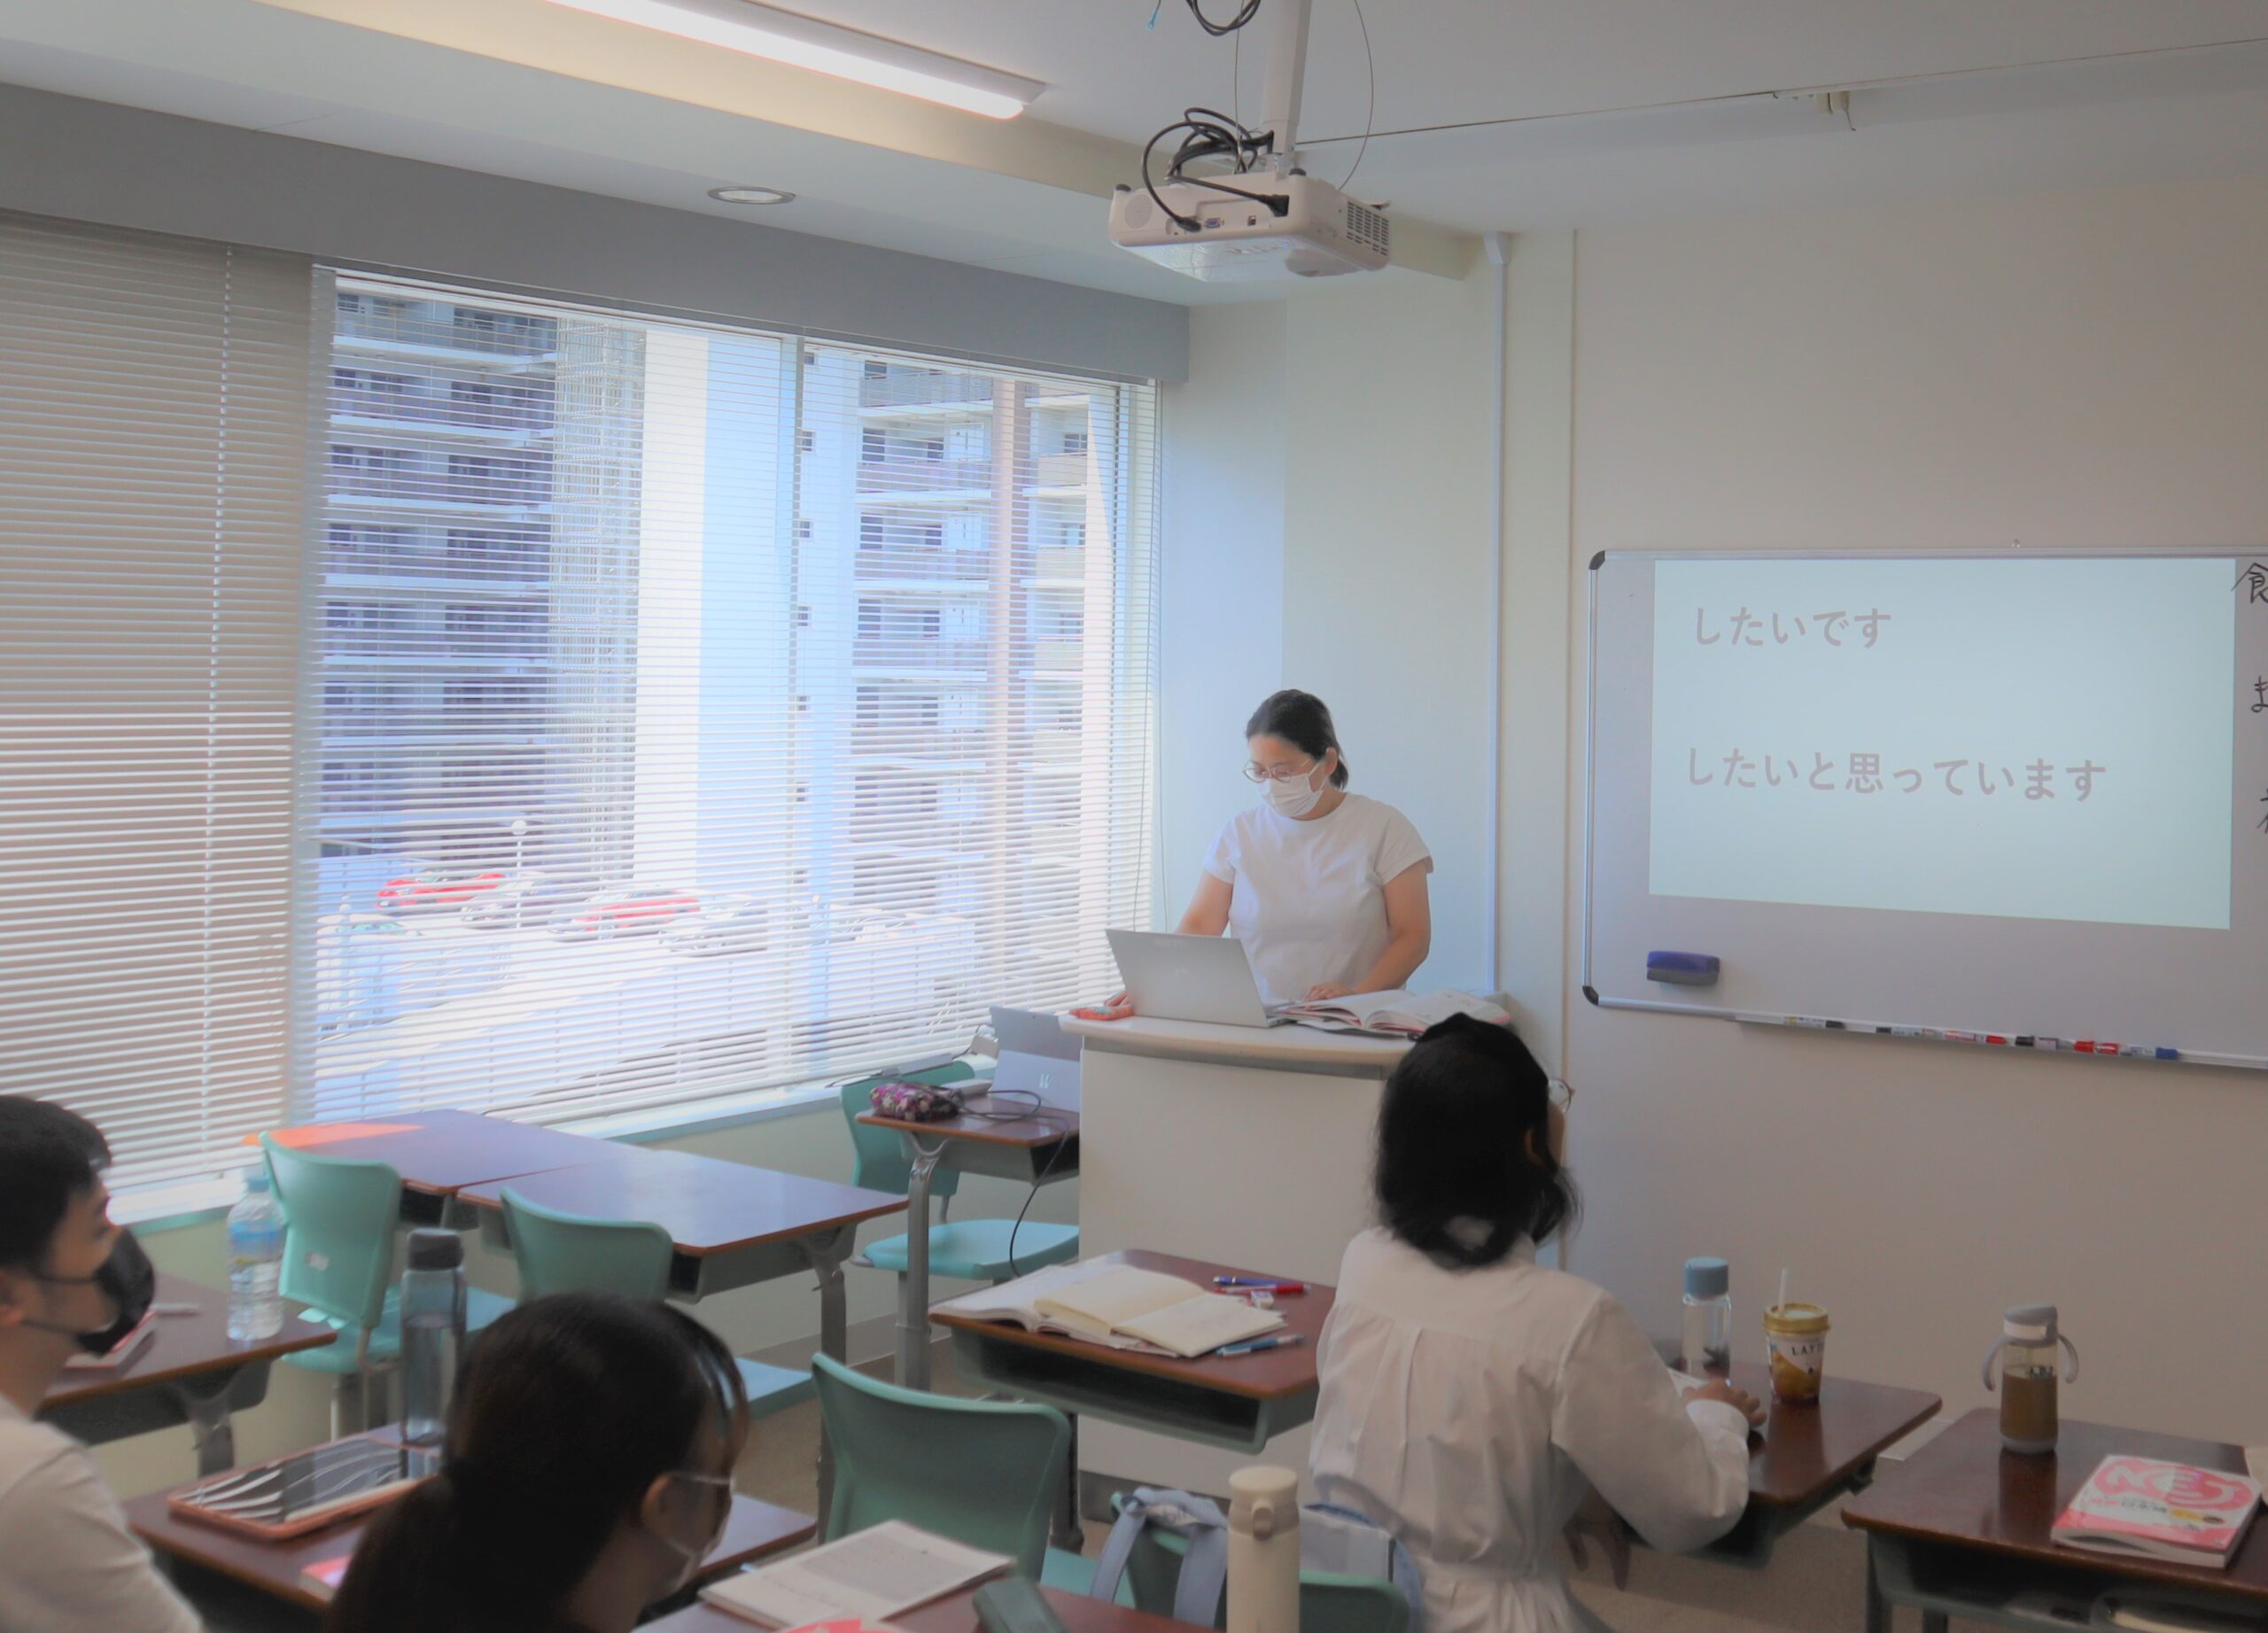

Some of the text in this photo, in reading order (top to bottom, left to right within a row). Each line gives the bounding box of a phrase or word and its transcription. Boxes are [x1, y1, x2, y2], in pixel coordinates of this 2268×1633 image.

[1696, 606, 1892, 649] したいです
[1688, 747, 2107, 802] したいと思っています
